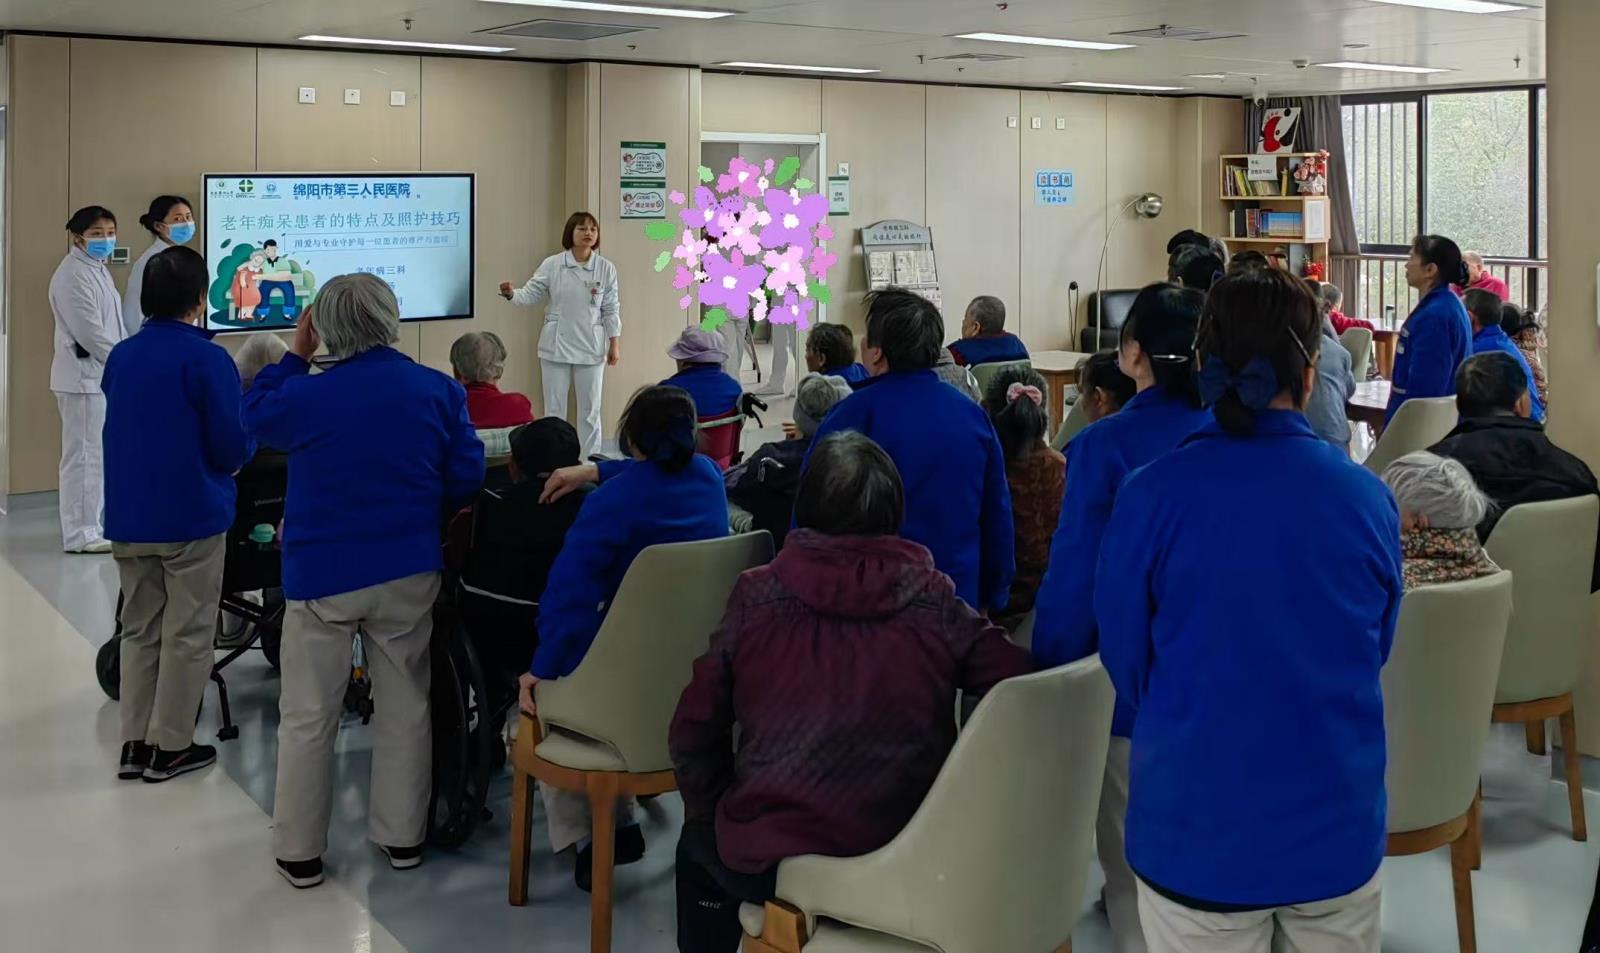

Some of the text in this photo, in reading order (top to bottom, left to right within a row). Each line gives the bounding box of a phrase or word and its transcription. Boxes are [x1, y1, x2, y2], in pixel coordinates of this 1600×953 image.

[293, 182, 411, 197] 绵阳市第三人民医院
[221, 211, 461, 231] 老年痴呆患者的特点及照护技巧
